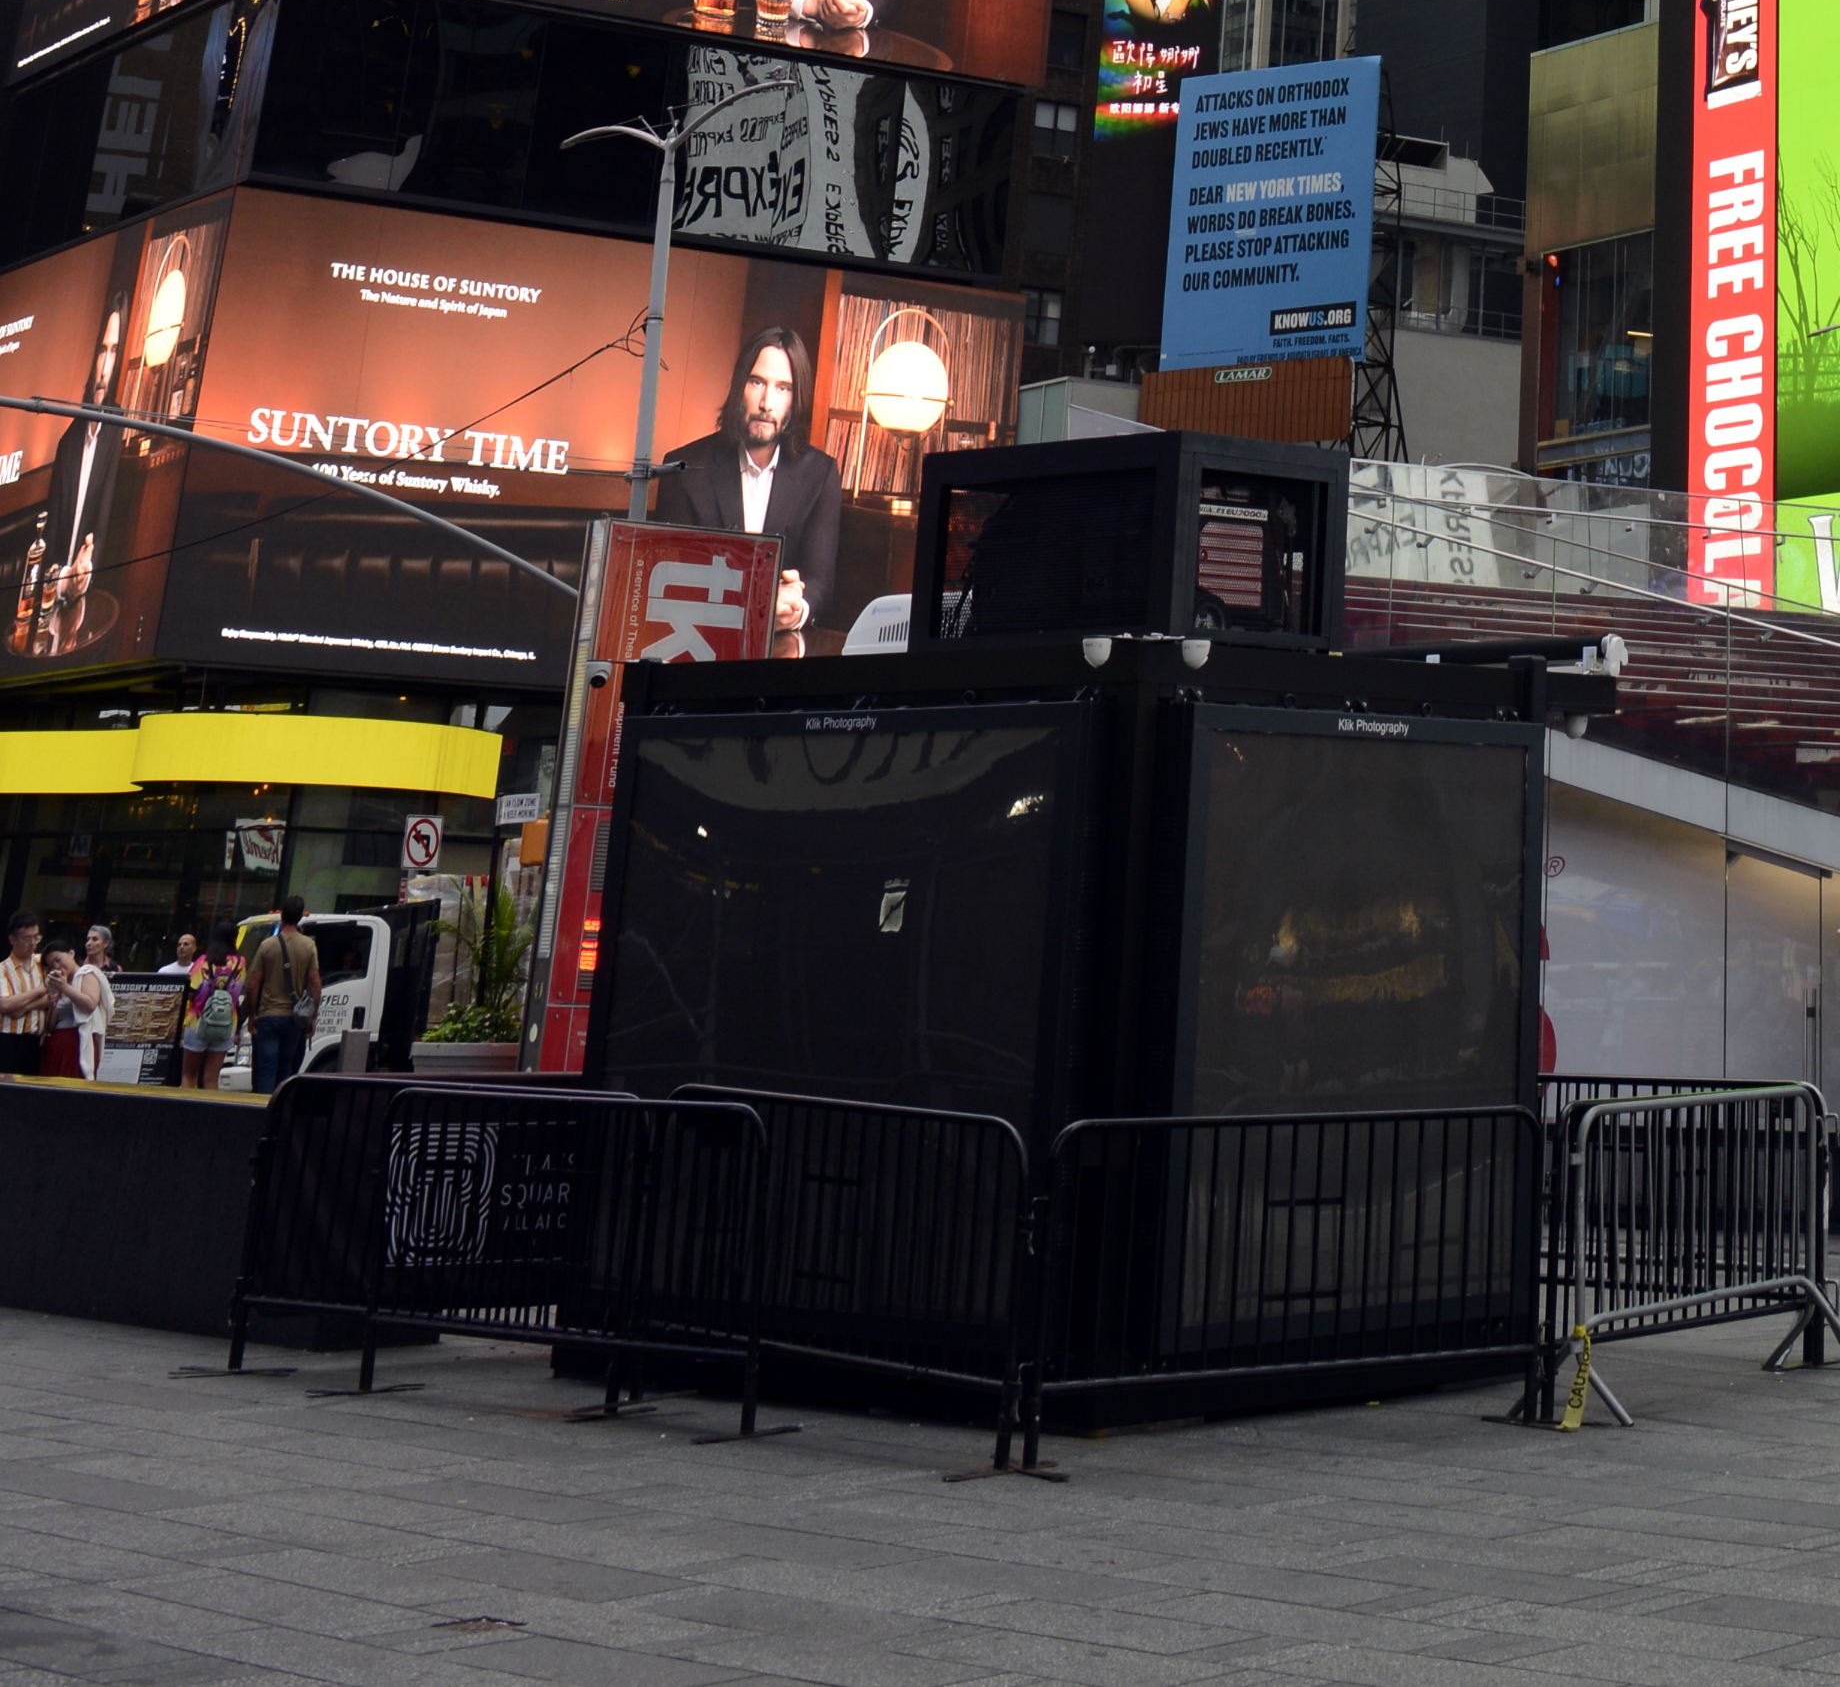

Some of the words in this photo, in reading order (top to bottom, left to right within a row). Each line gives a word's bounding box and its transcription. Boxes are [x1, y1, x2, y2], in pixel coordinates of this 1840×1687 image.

[1195, 89, 1254, 114] ATTACKS
[1256, 87, 1275, 107] ON
[1277, 78, 1351, 105] ORTHODOX
[1193, 119, 1229, 142] JEWS
[1231, 115, 1267, 138] HAVE
[1268, 111, 1308, 135] MORE
[1310, 106, 1347, 130] THAN
[1191, 144, 1252, 170] DOUBLED
[1188, 184, 1224, 207] DEAR
[1226, 180, 1257, 204] NEW
[1259, 176, 1295, 200] YORK
[1297, 171, 1346, 196] TIMES,
[1187, 213, 1235, 235] WORDS
[1237, 209, 1256, 230] DO
[1259, 205, 1304, 229] BREAK
[1306, 200, 1356, 224] BONES.
[1707, 148, 1765, 300] FREE
[1184, 241, 1234, 264] PLEASE
[1236, 236, 1272, 259] STOP
[1273, 228, 1350, 256] ATTACKING
[1182, 272, 1210, 293] OUR
[1212, 263, 1300, 290] COMMUNITY.
[1274, 307, 1353, 331] KNOWUS.ORG
[1272, 338, 1294, 349] FAITH.
[1294, 335, 1328, 347] FREEDOM.
[1328, 333, 1351, 345] FACTS.
[1218, 368, 1267, 382] LAMAR
[247, 407, 455, 462] SUNTORY
[464, 429, 570, 476] TIME
[637, 559, 645, 567] a
[631, 568, 643, 612] service
[629, 614, 638, 628] of
[624, 629, 638, 660] Thea
[1338, 718, 1354, 731] Klik
[1356, 719, 1410, 737] Photography
[110, 983, 148, 993] IDNIGHT
